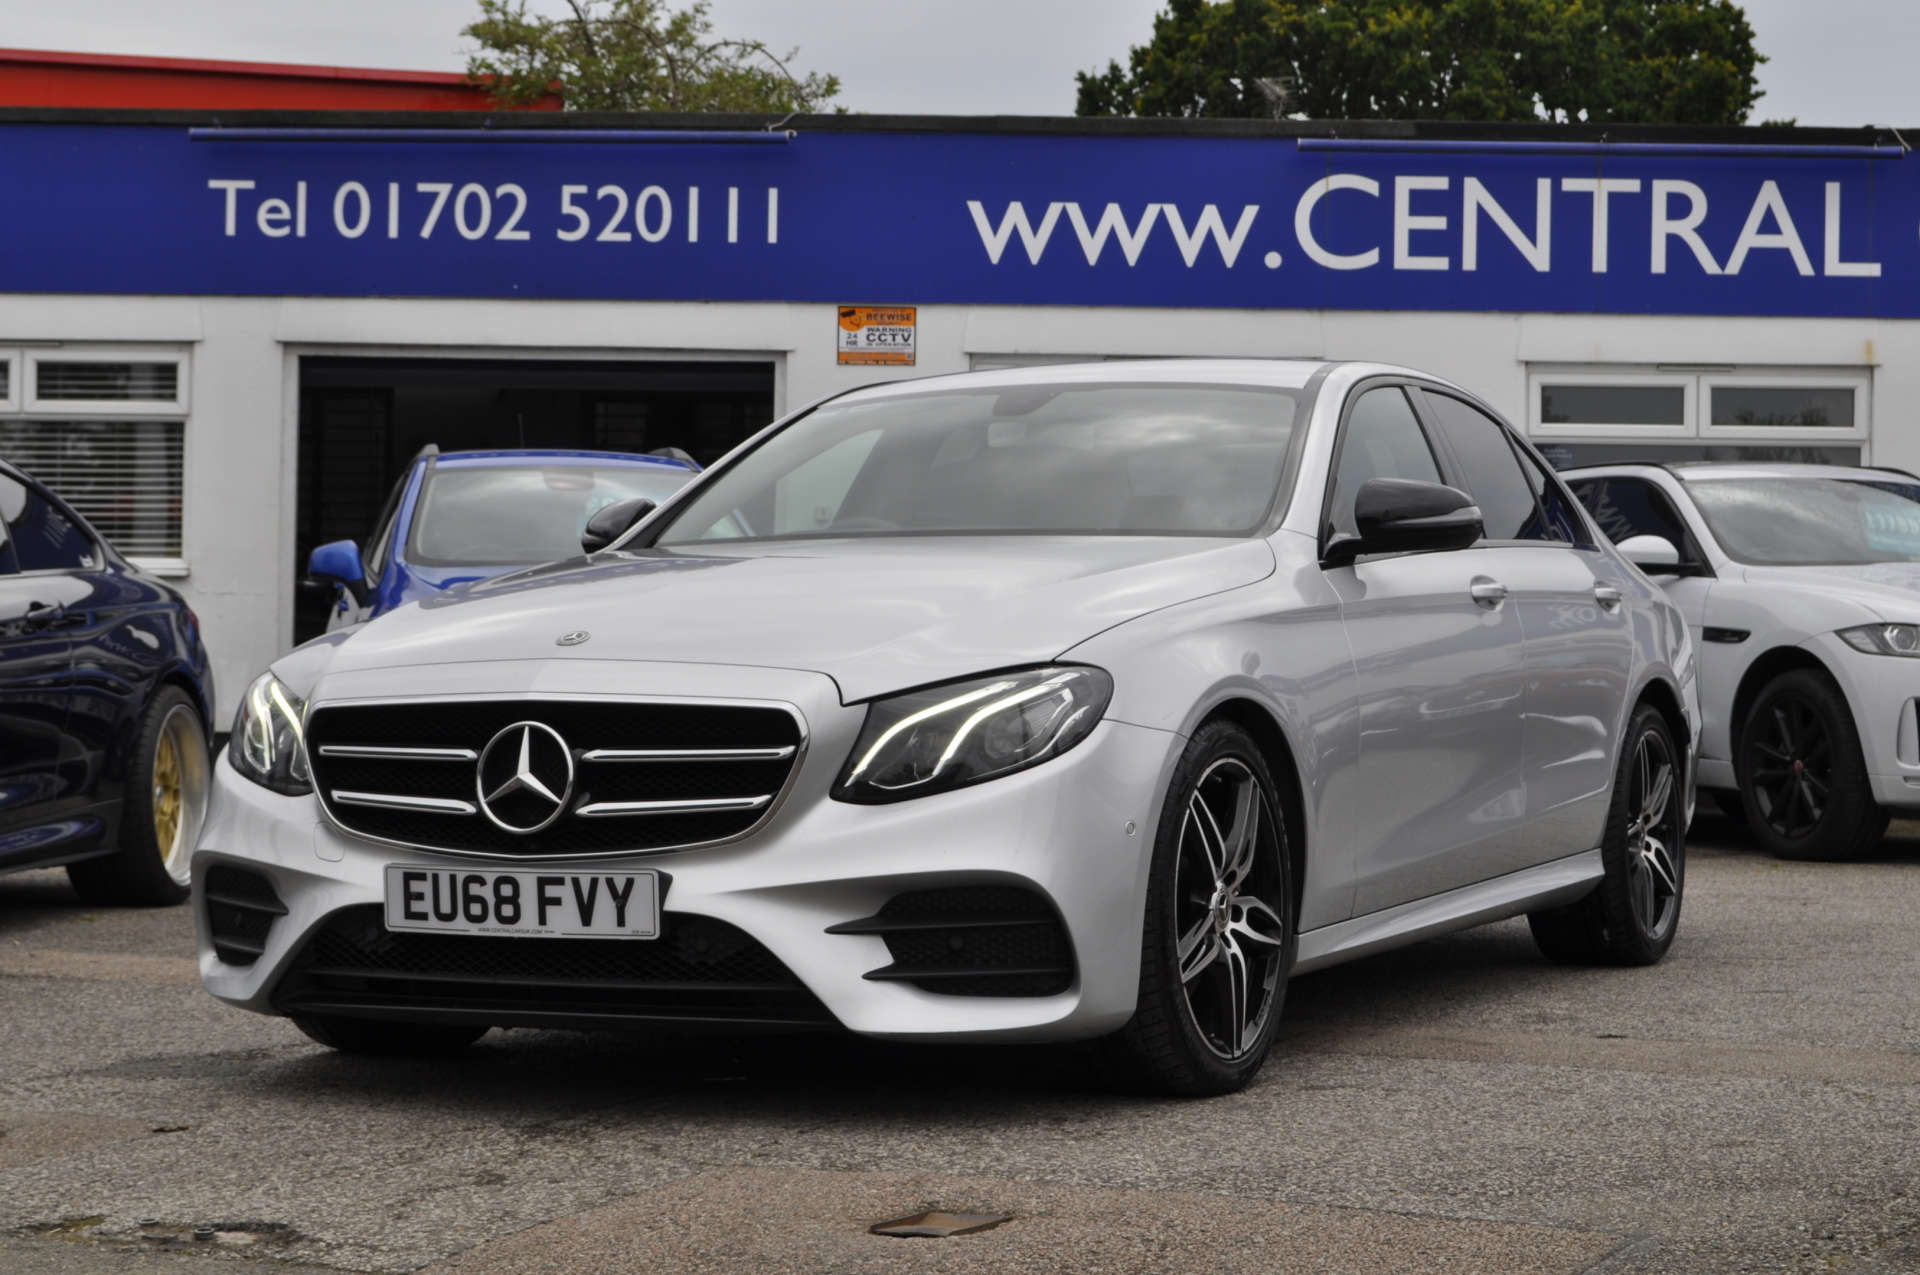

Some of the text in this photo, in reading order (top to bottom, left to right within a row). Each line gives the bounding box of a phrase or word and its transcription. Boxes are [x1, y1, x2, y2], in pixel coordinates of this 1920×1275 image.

[207, 179, 779, 244] Tel 01702 520111
[866, 333, 912, 342] CCTV
[402, 871, 635, 928] EU68 FVY
